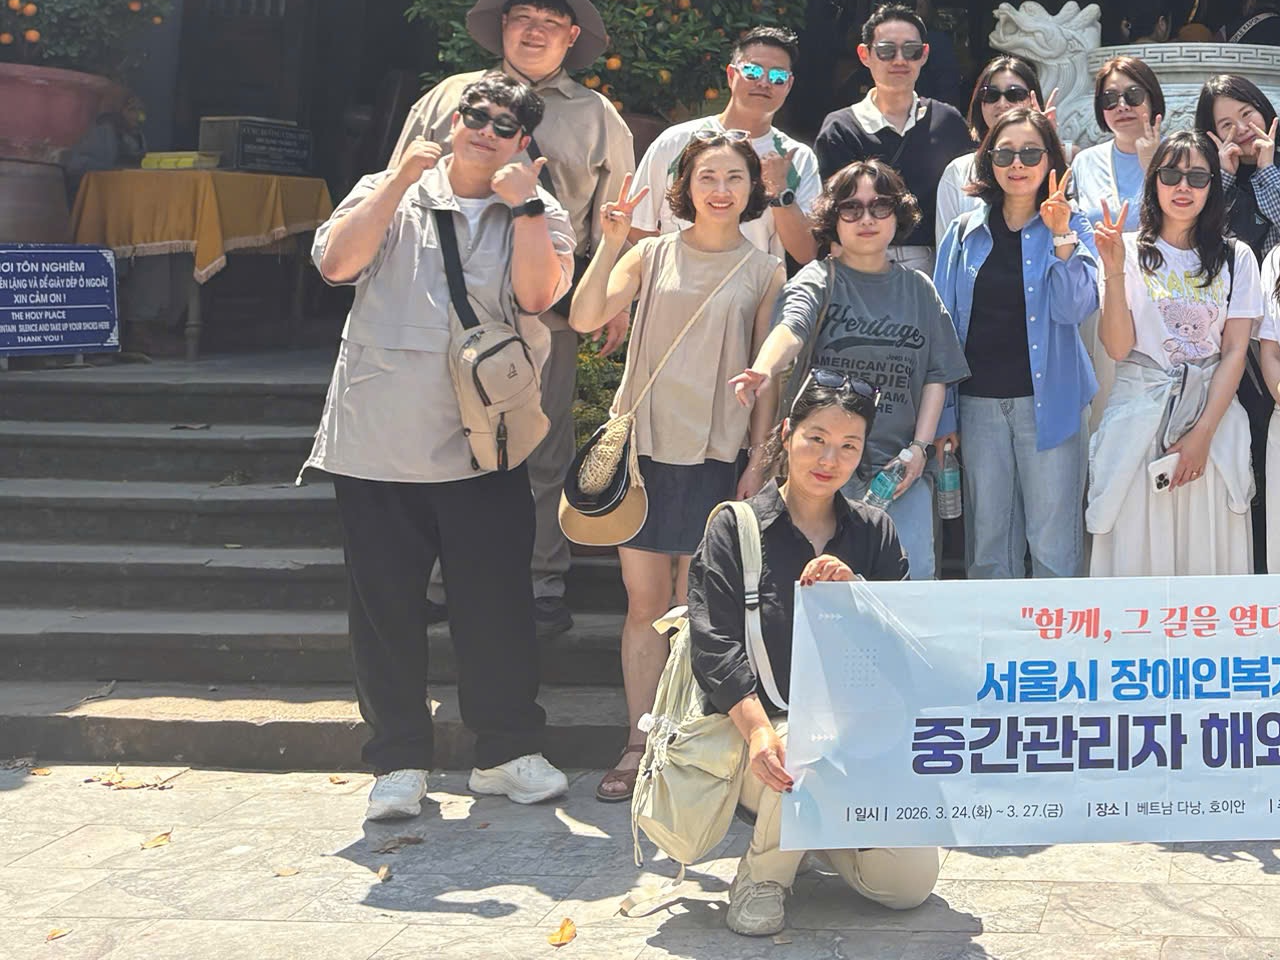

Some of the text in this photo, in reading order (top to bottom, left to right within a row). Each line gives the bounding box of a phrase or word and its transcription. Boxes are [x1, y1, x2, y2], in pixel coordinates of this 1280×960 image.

[0, 260, 85, 273] ƠI TÔN NGHIÊM
[14, 293, 28, 304] XIN
[11, 310, 66, 320] THE HOLY PLACE
[18, 323, 38, 333] SILENCE
[38, 323, 50, 332] AND
[50, 322, 62, 332] TAKE
[62, 322, 68, 331] UP
[69, 322, 82, 331] YOUR
[819, 303, 922, 348] Heritage
[17, 335, 42, 343] THANK
[43, 334, 60, 342] YOU
[1020, 606, 1112, 643] "함께,
[1121, 608, 1152, 634] 그
[1159, 604, 1221, 639] 길을
[977, 658, 1098, 703] 서울시
[911, 714, 1189, 776] 중간관리자
[896, 806, 931, 820] 2026.
[935, 806, 947, 820] 3.
[951, 804, 993, 820] 24.(화)
[1006, 804, 1019, 819] 3.
[1022, 803, 1064, 819] 27.(금)
[1136, 800, 1173, 816] 베트남
[1177, 800, 1205, 816] 다낭,
[1208, 799, 1246, 815] 호이안
